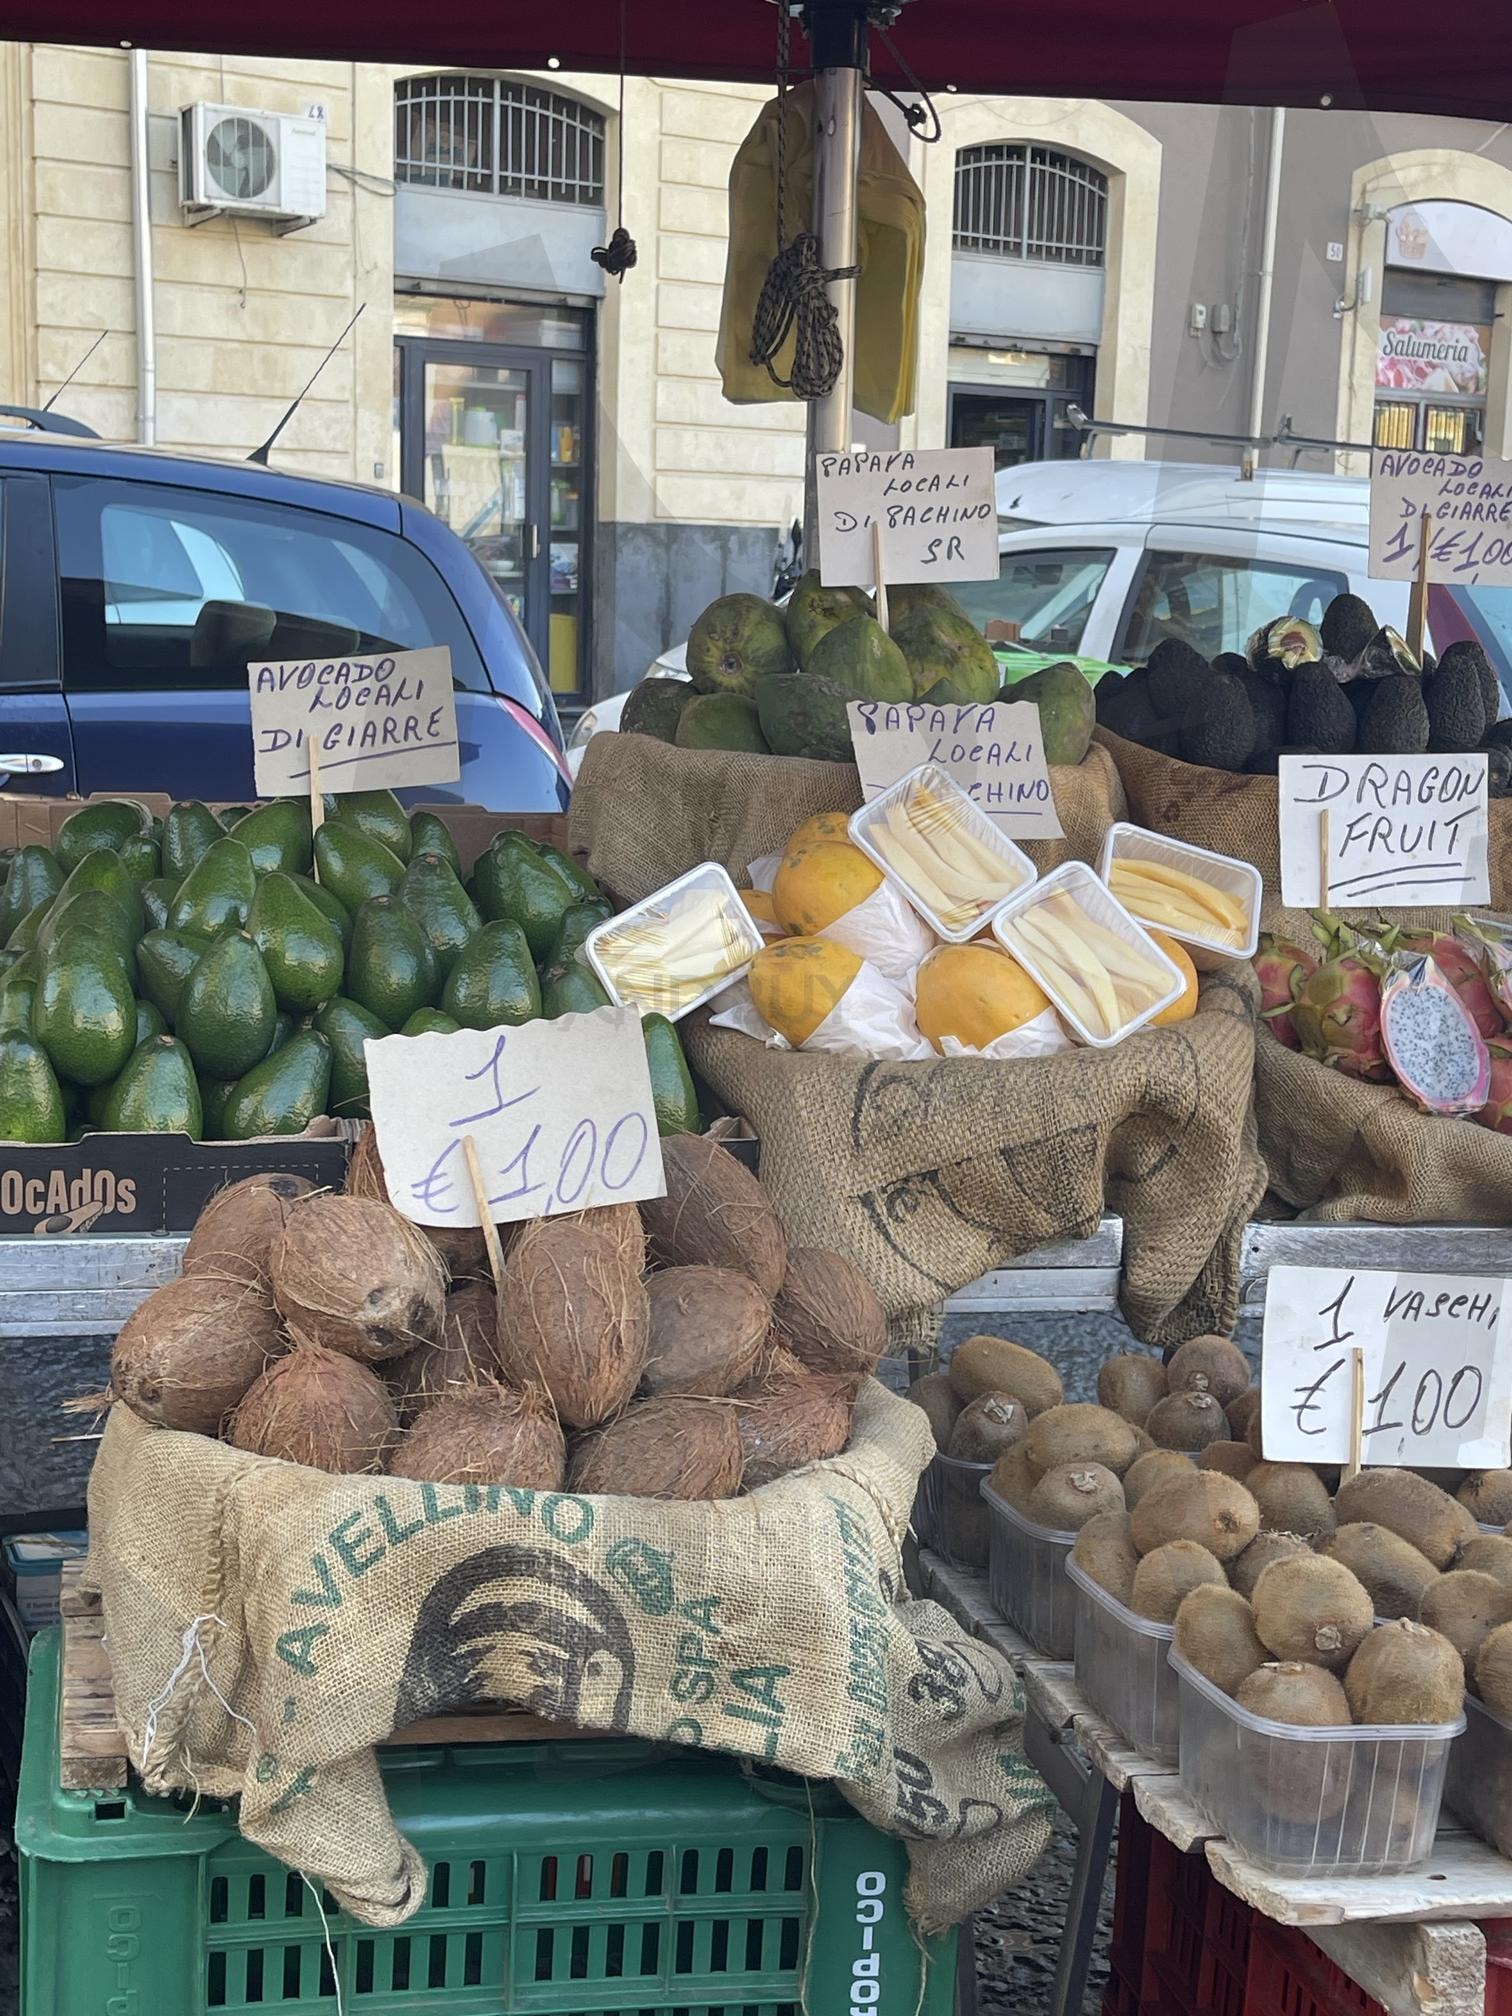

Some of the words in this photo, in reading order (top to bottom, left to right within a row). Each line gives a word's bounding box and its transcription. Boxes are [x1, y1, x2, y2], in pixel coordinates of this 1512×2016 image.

[1382, 330, 1469, 363] Salumeria
[1380, 453, 1484, 479] AVOCADO
[883, 474, 969, 496] LOCALI
[257, 657, 396, 693] AVOCADO
[309, 677, 424, 713] LOCALI
[258, 728, 303, 753] DI
[323, 706, 444, 750] GIARRE
[928, 738, 1032, 767] LOCALI
[966, 779, 1049, 803] CHINO
[1293, 763, 1485, 808] DRAGON
[1339, 805, 1480, 857] FRUIT
[450, 1035, 541, 1127] 1
[1313, 1275, 1355, 1350] 1
[275, 1483, 595, 1677] AVELLINO
